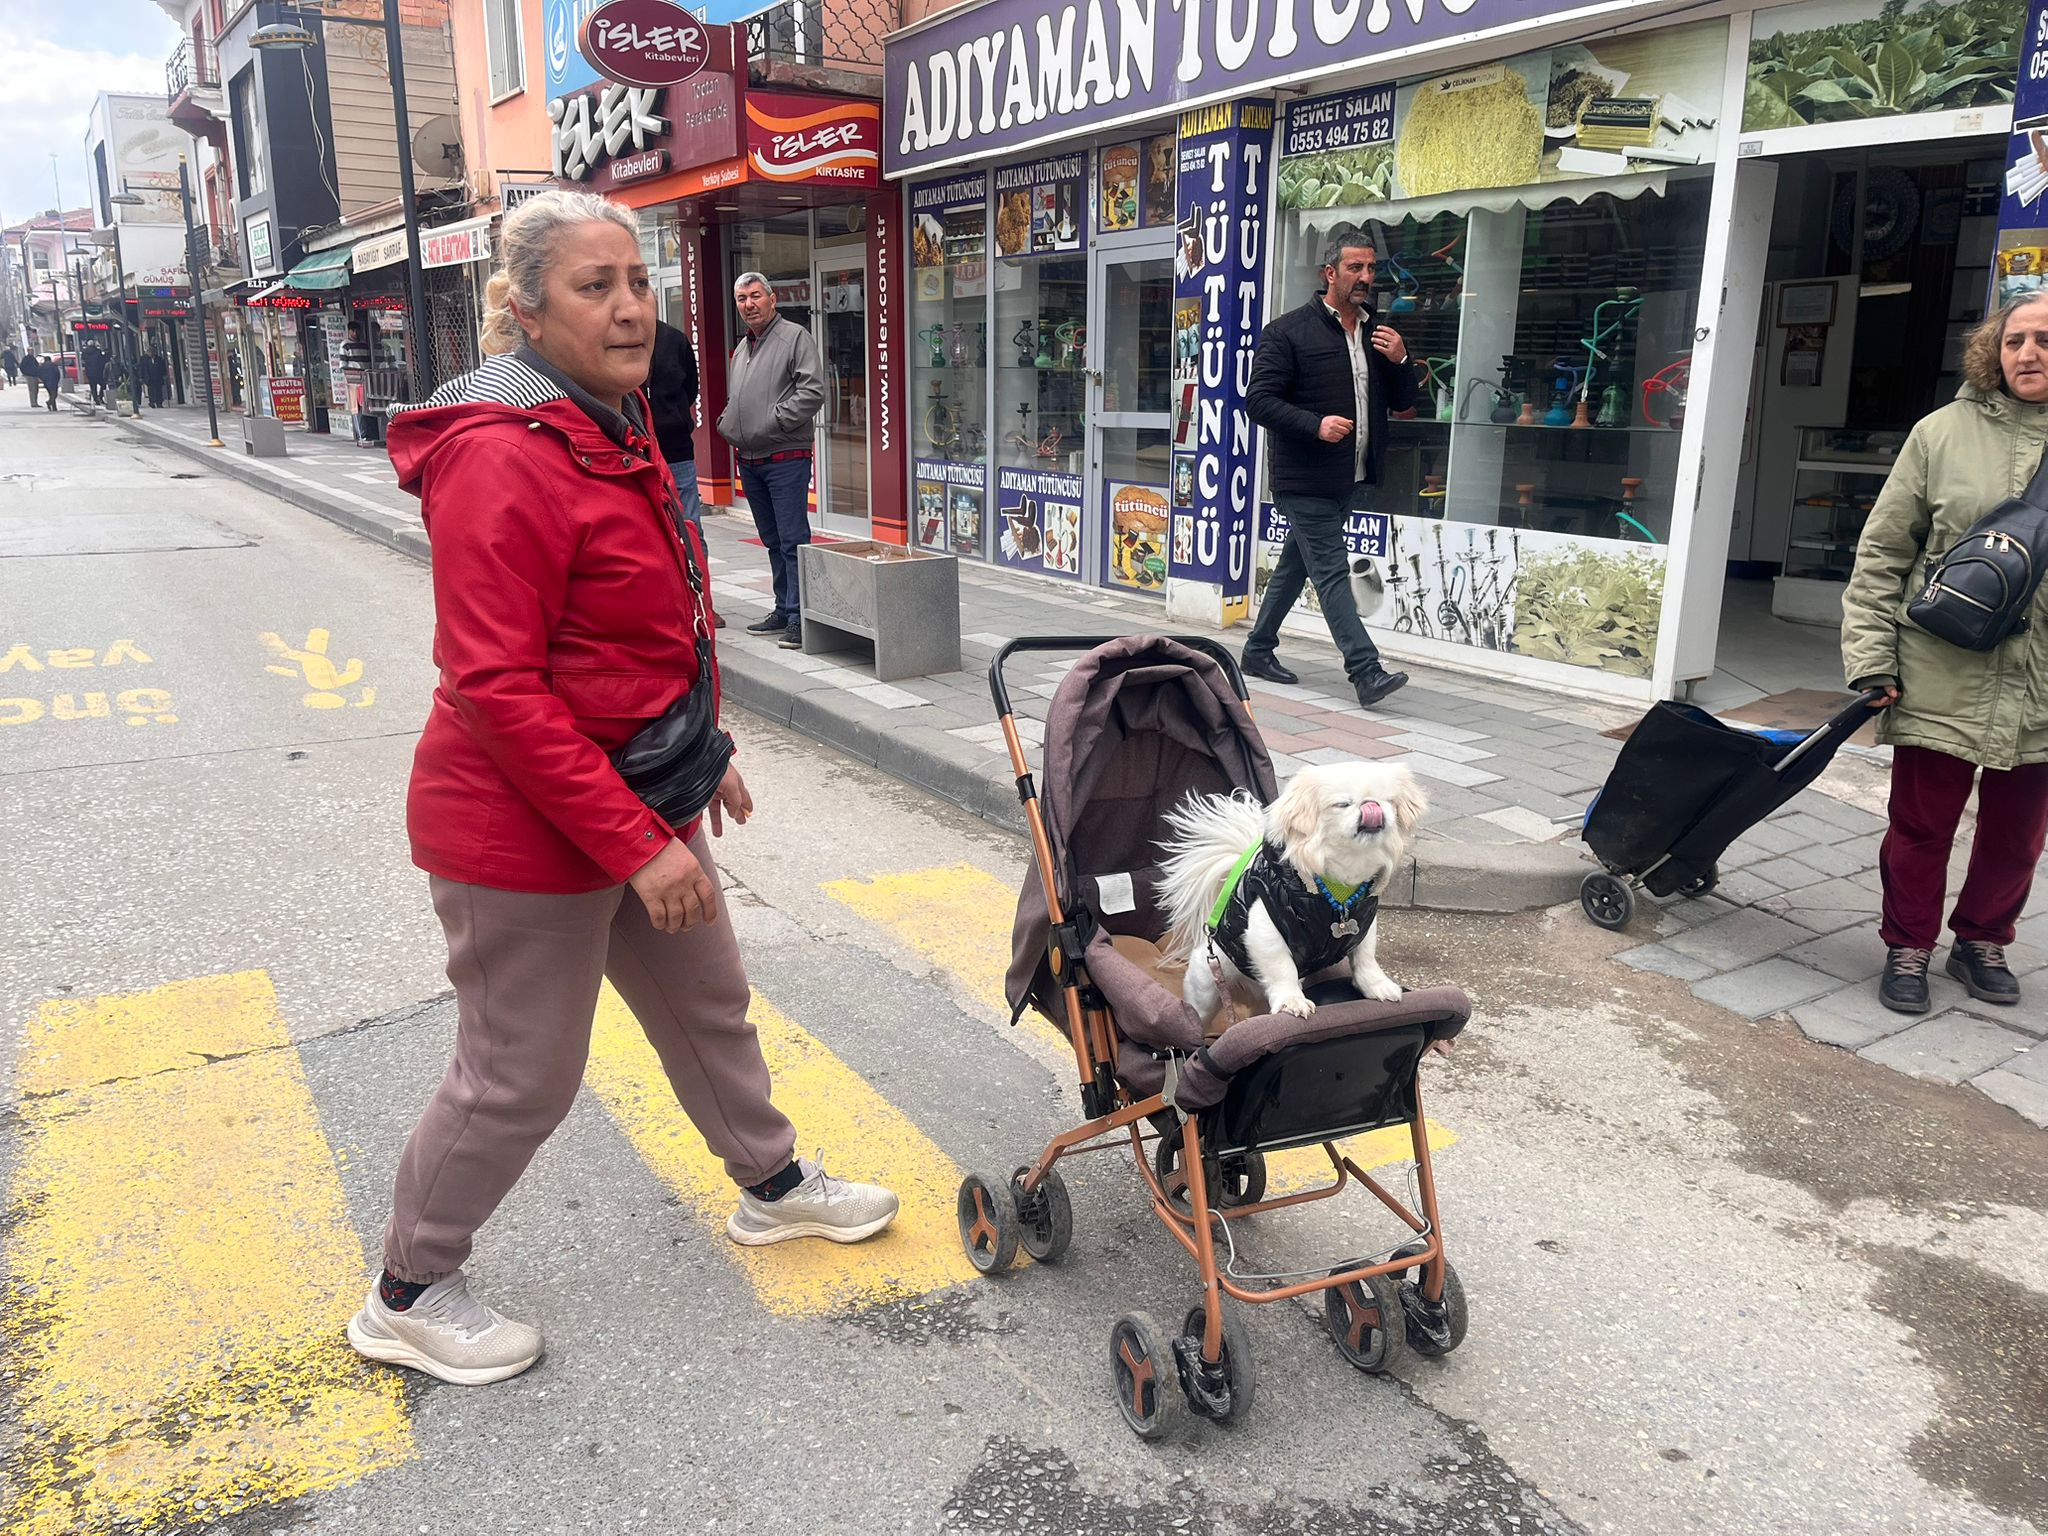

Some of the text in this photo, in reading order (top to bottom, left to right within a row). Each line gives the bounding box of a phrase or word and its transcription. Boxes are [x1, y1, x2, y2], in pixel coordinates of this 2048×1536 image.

[595, 19, 702, 53] İŞLER
[645, 51, 699, 63] Kitabevleri
[900, 0, 1156, 155] ADIYAMAN
[1292, 90, 1392, 131] ŞEVKET SALAN
[771, 122, 863, 158] İŞLER
[1290, 118, 1389, 152] 0553 494 75 82
[611, 152, 659, 180] Kitabevleri
[816, 166, 865, 179] KIRTASİYE
[996, 153, 1081, 190] ADIYAMAN TÜTÜNCÜSÜ
[914, 176, 985, 208] ADIYAMAN TÜTÜNCÜSÜ
[876, 214, 890, 450] www.isler.com.tr
[1197, 140, 1231, 567] TÜTÜNCÜ
[916, 462, 985, 486] ADIYAMAN TÜTÜNCÜSÜ
[1000, 471, 1083, 498] ADIYAMAN TÜTÜNCÜSÜ
[1114, 498, 1168, 518] tütüncü
[1360, 538, 1380, 555] 82
